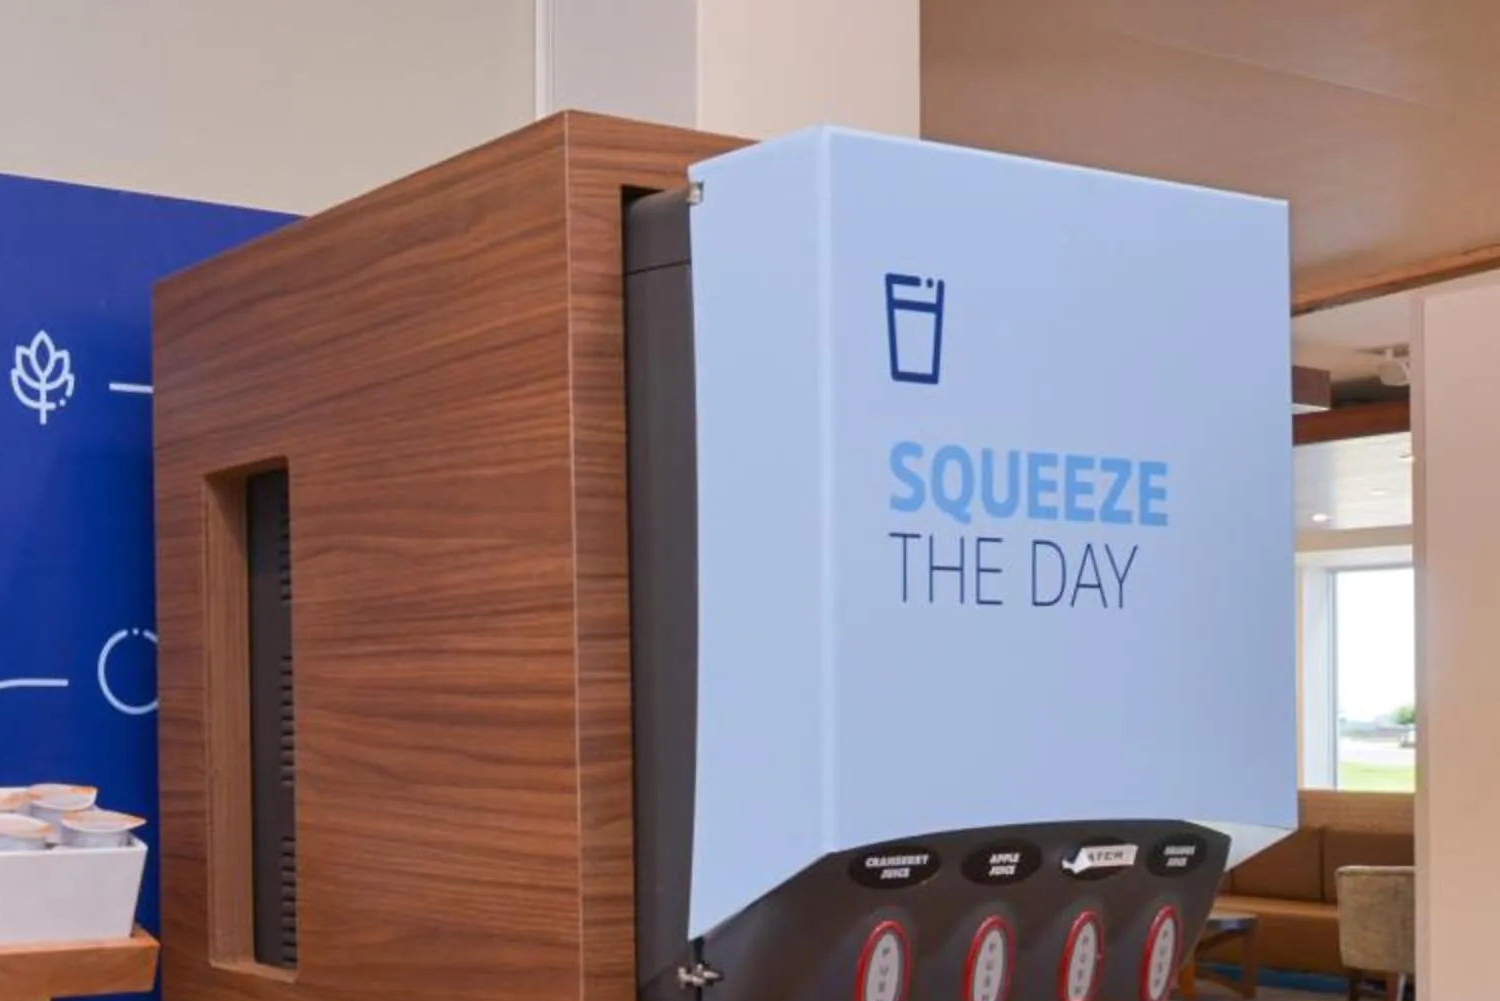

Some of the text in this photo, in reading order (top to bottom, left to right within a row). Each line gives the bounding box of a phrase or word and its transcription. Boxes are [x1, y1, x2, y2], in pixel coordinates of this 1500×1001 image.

[889, 441, 1169, 527] SQUEEZE
[888, 531, 1139, 609] THE DAY
[865, 854, 929, 868] CRANBERRY
[989, 853, 1021, 864] APPLE
[880, 867, 911, 880] JUICE
